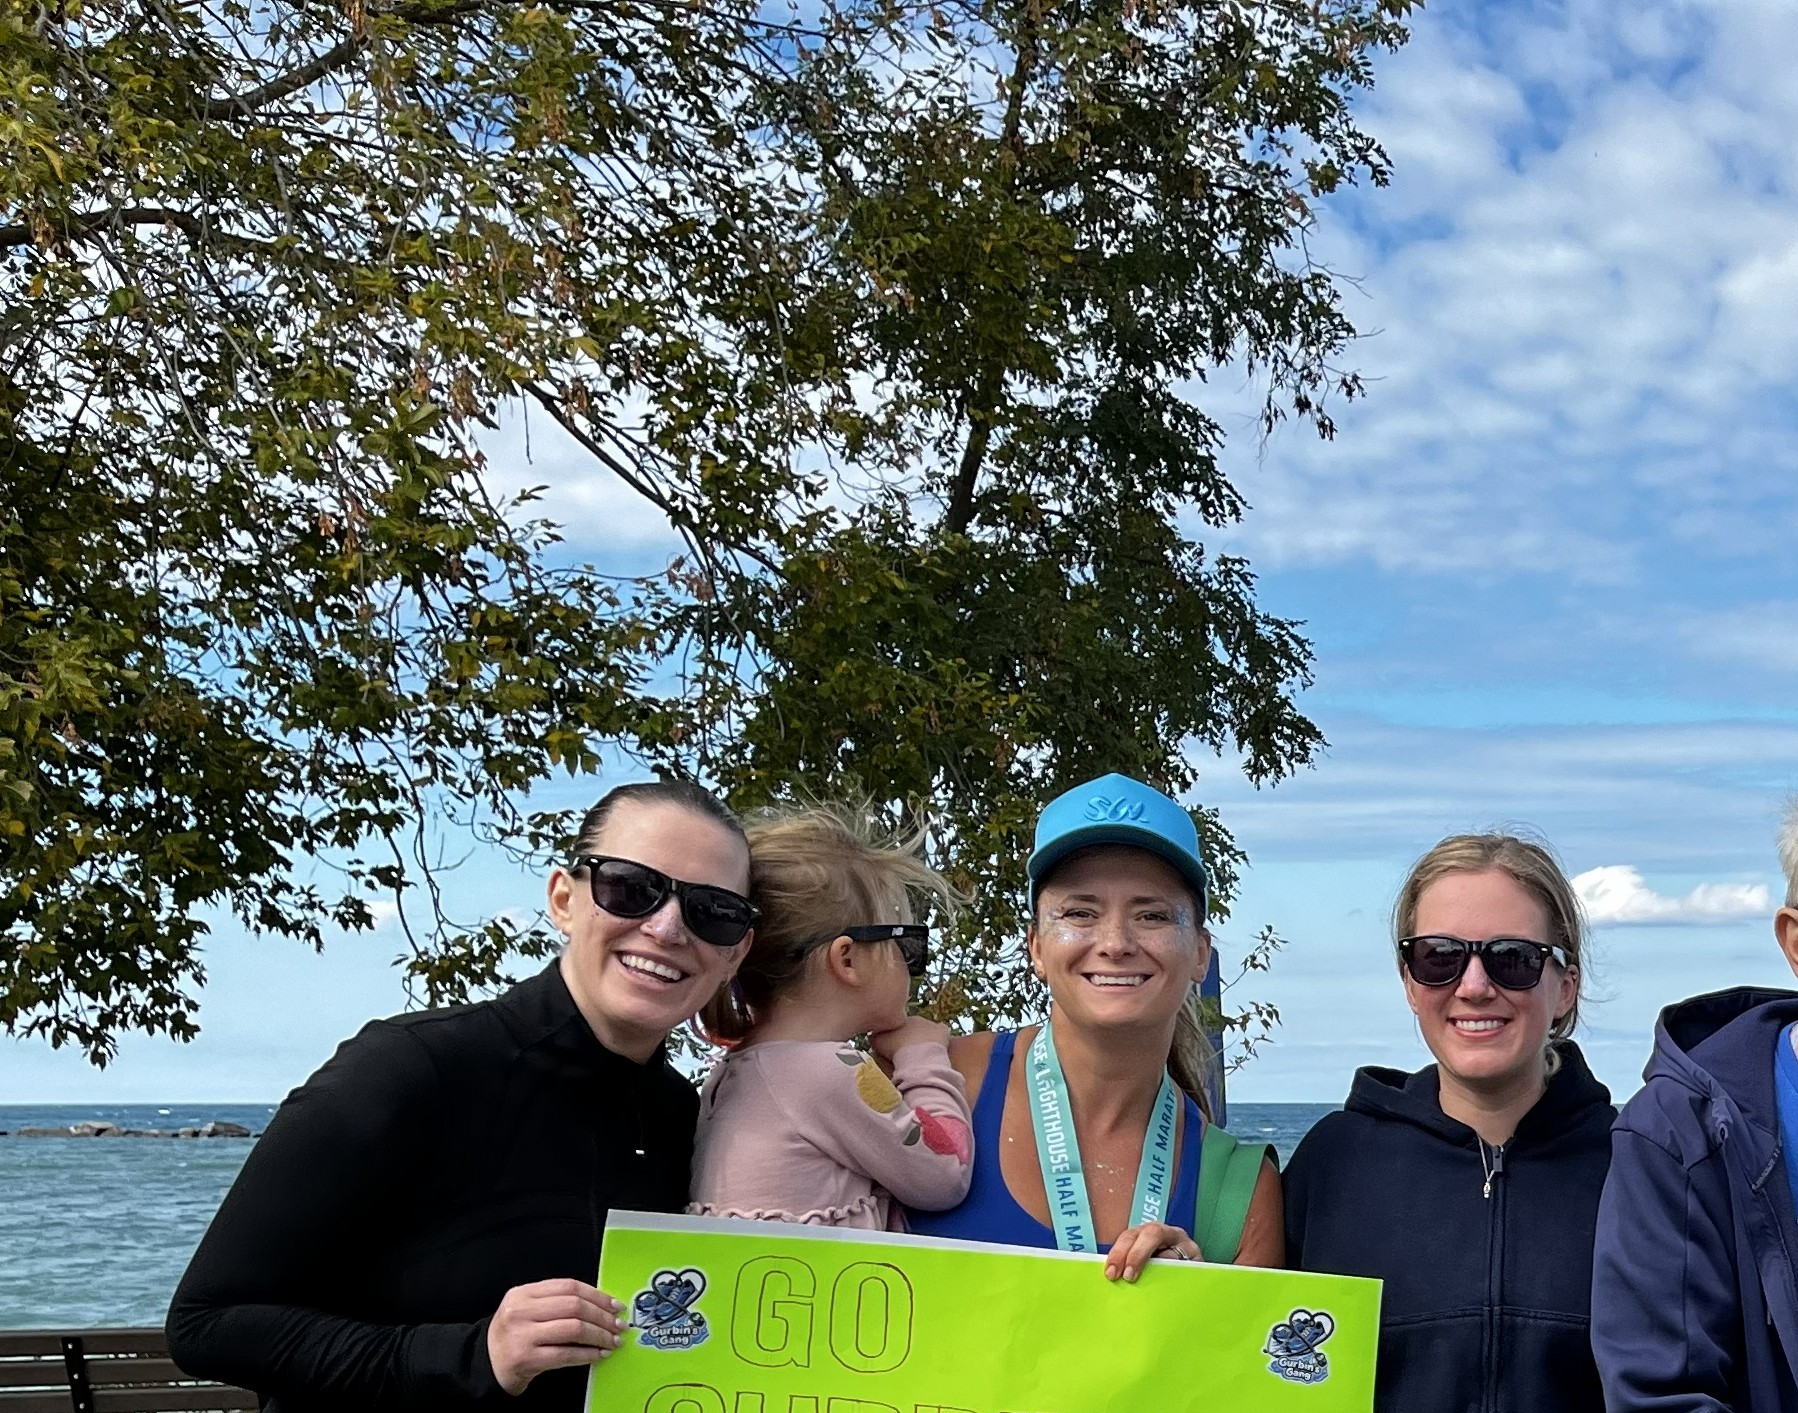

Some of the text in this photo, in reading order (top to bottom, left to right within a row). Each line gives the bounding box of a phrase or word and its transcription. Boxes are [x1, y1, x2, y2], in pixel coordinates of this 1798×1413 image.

[1147, 1153, 1166, 1196] HALF
[1055, 1176, 1078, 1217] HALF
[730, 1255, 915, 1373] GO
[659, 1335, 689, 1345] Gang
[1285, 1367, 1312, 1381] Gang
